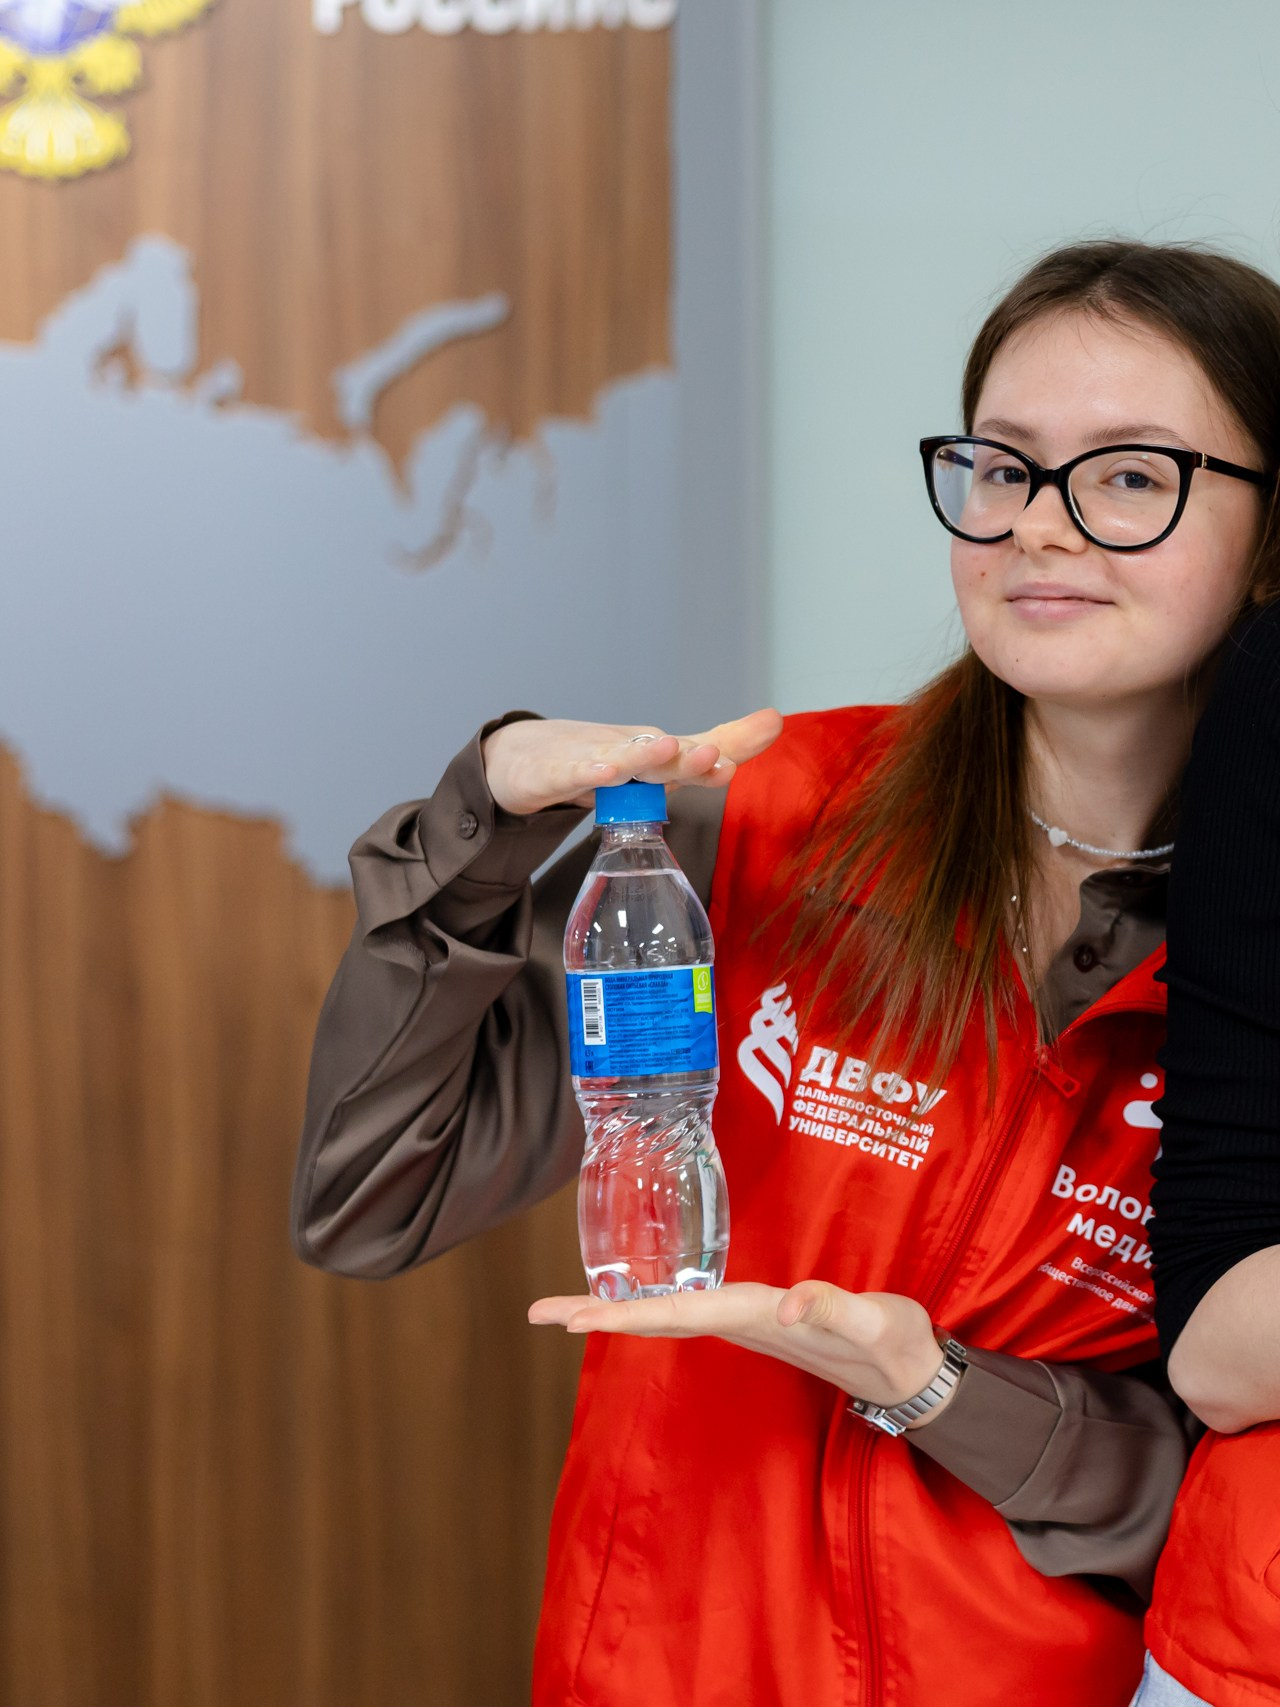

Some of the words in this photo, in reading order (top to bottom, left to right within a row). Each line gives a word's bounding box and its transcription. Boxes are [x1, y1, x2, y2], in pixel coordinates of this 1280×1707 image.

[799, 1045, 948, 1116] ДВФУ
[792, 1099, 930, 1154] ФЕДЕРАЛЬНЫЙ
[795, 1084, 935, 1138] ДАЛЬНЕВОСТОЧНЫЙ
[788, 1114, 924, 1171] УНИВЕРСИТЕТ
